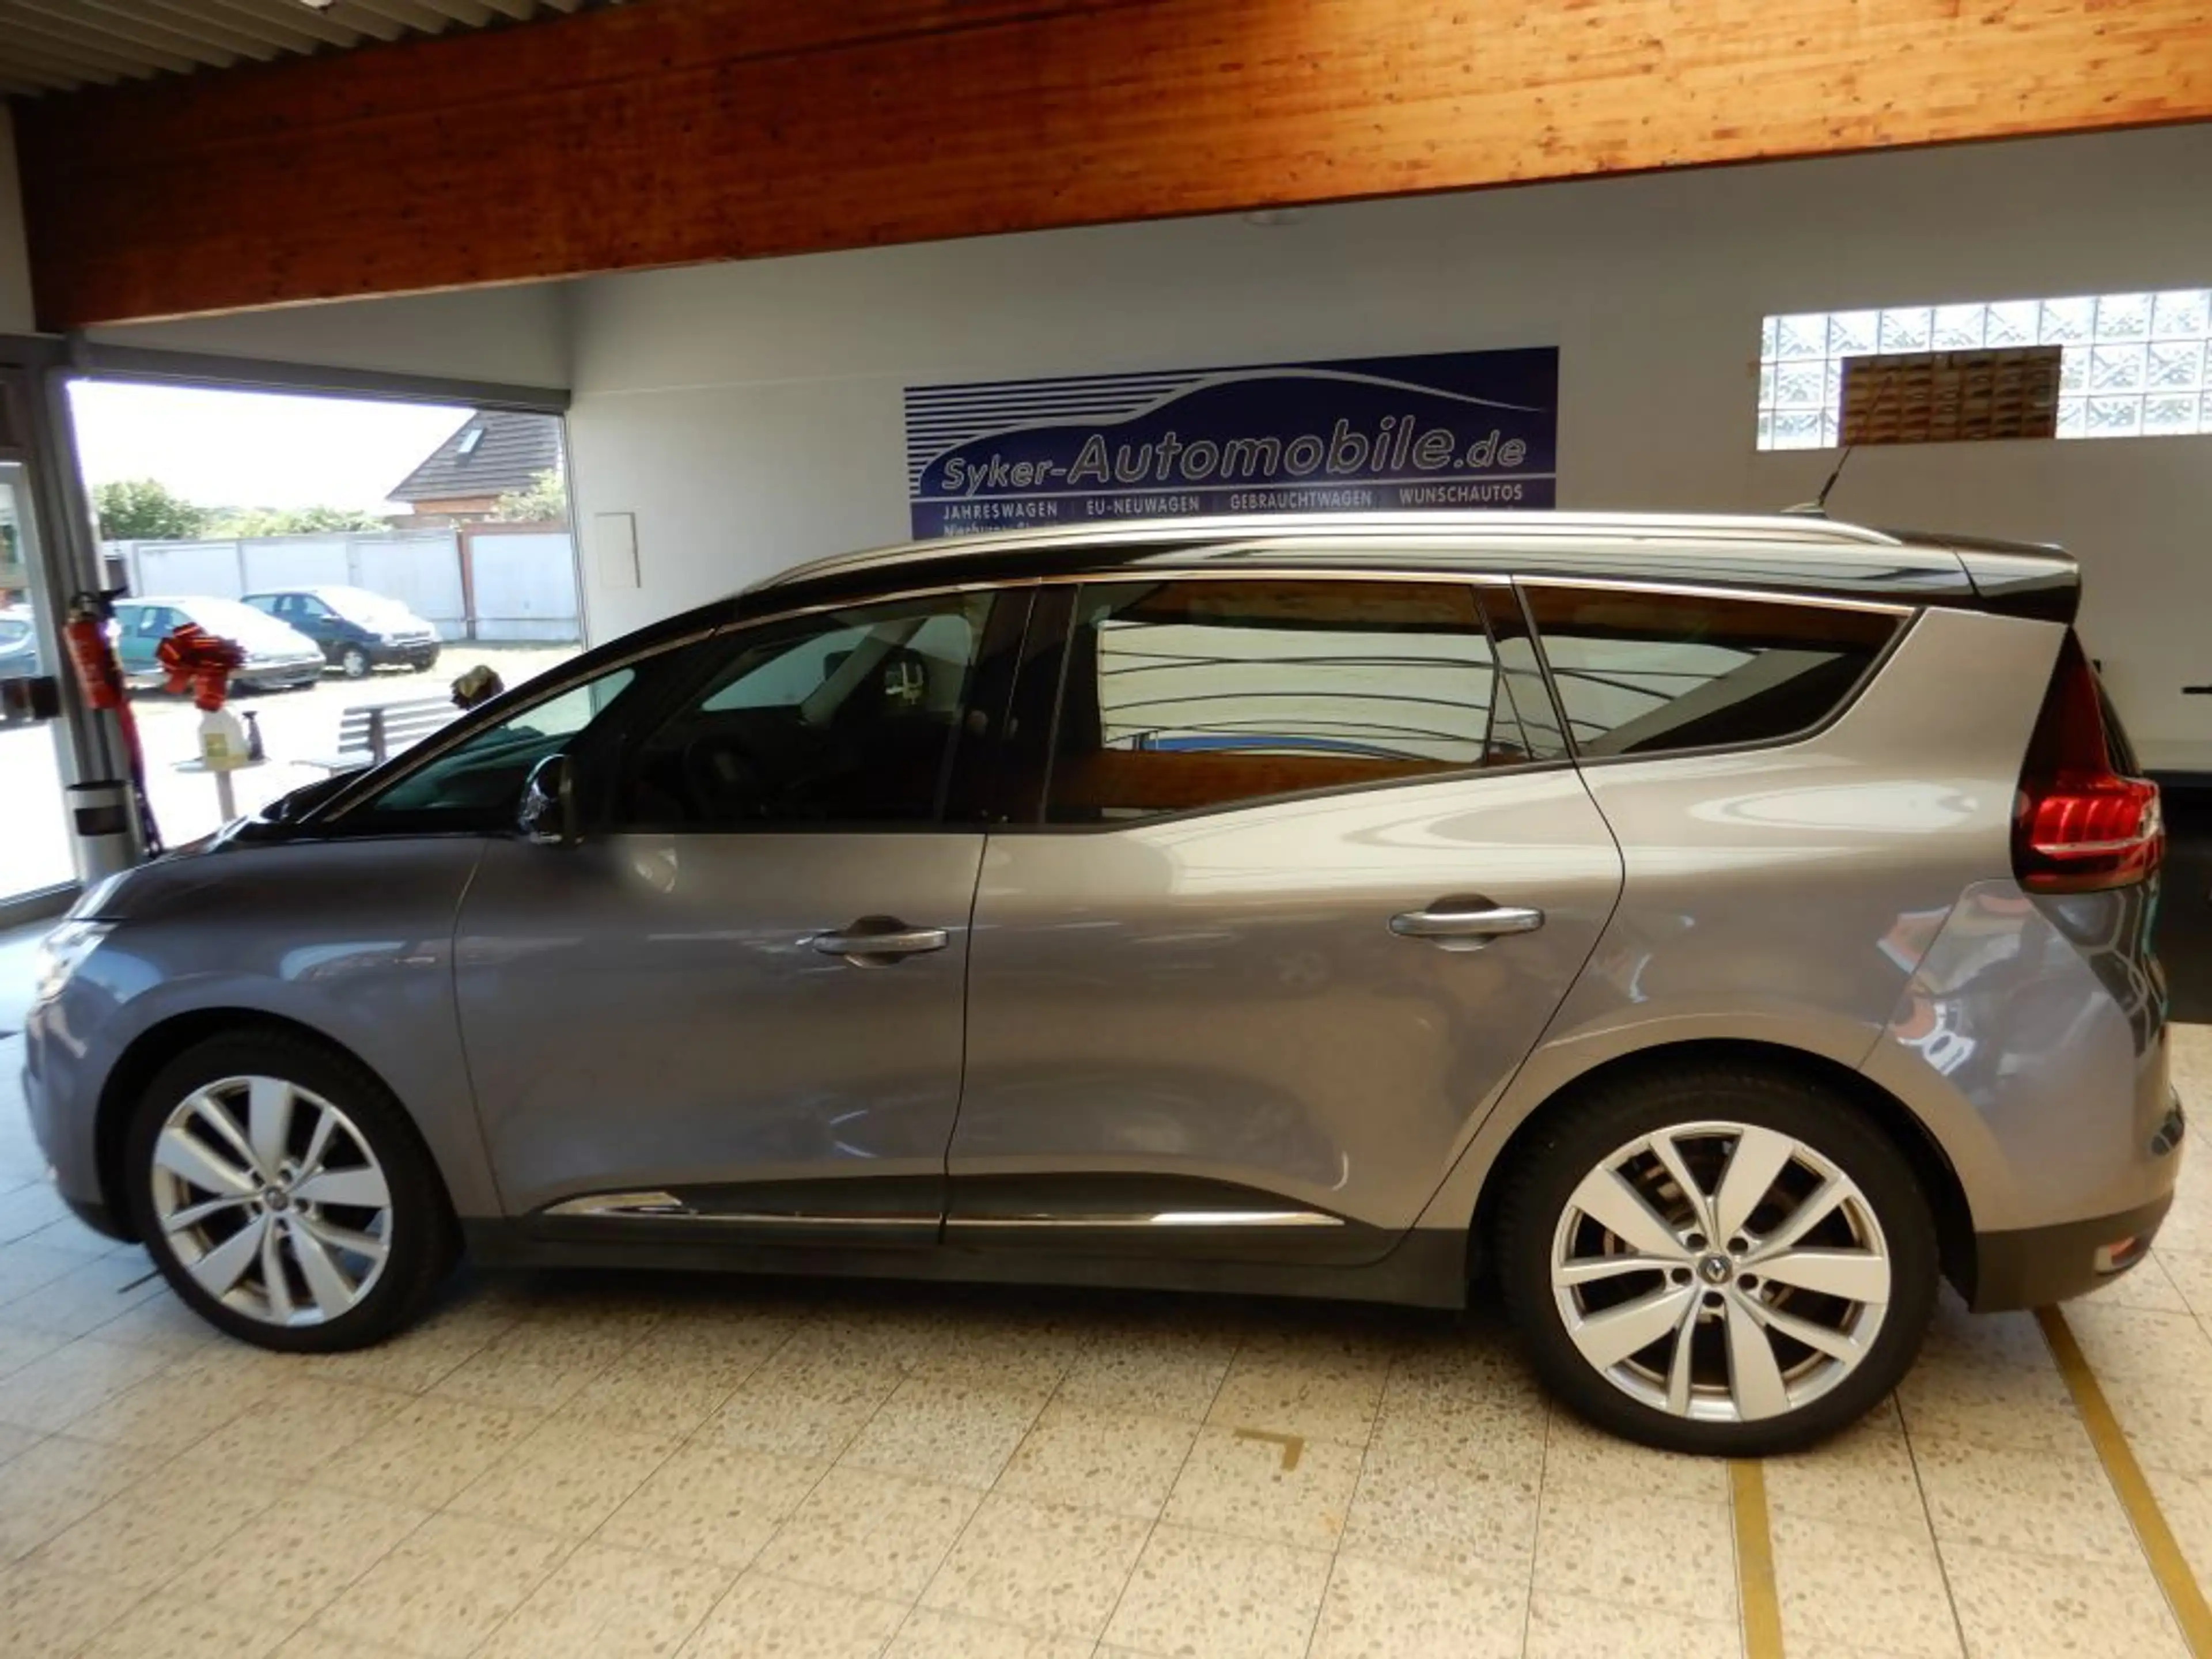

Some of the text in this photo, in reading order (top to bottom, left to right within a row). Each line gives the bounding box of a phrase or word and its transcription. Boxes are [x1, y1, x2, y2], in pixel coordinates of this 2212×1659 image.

[942, 415, 1527, 496] Syker-Automobile.de
[944, 484, 1522, 520] JAHRESWAGEN EU-NEUWAGEN GEBRAUCHTWAGEN WUNSCHAUTOS
